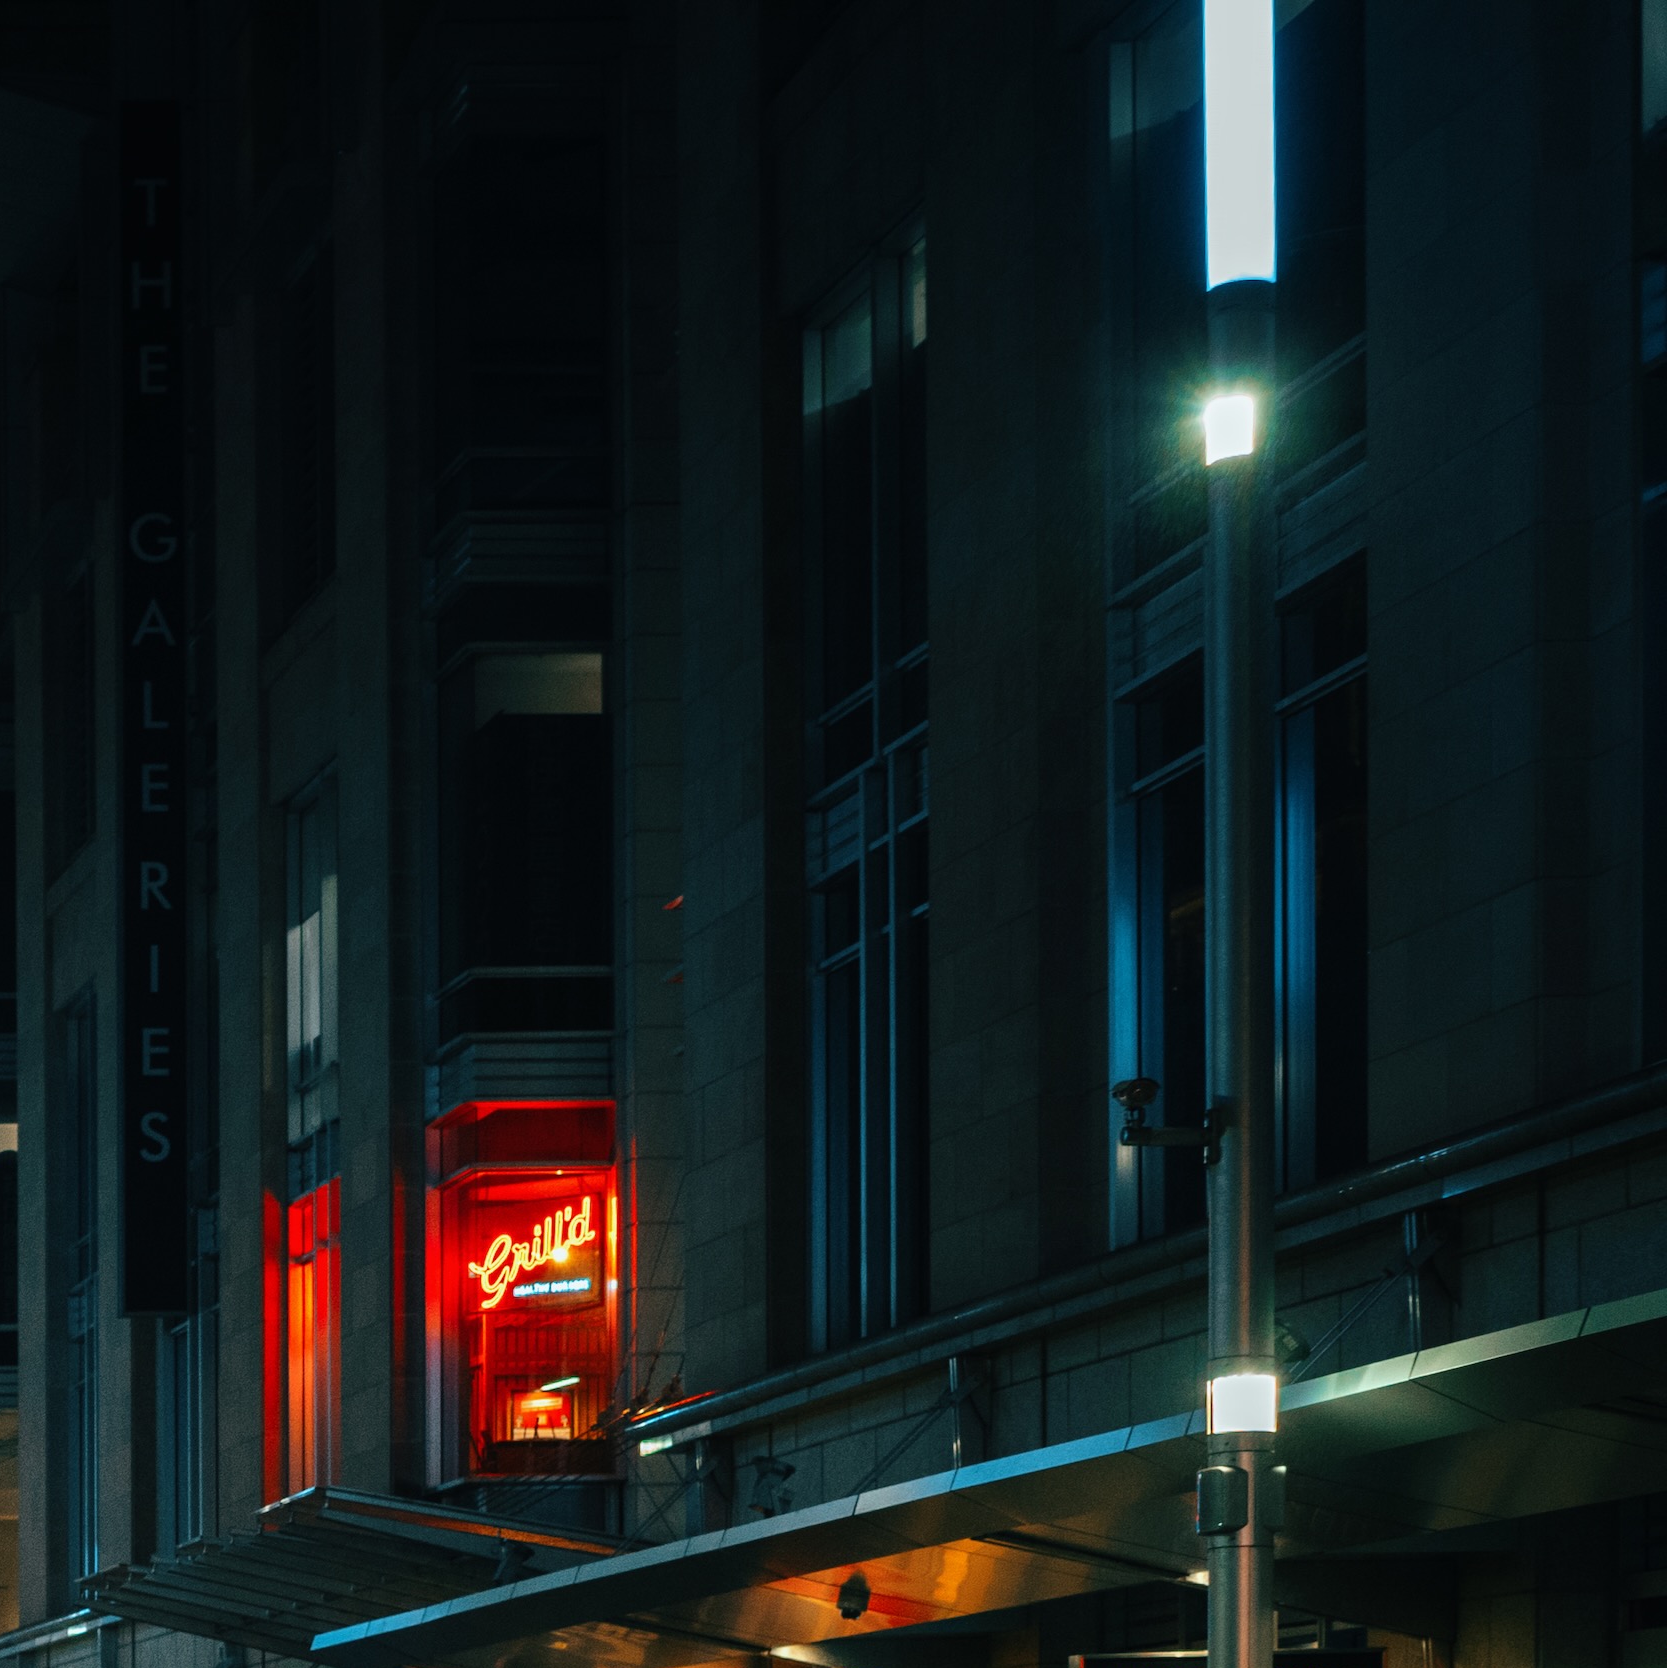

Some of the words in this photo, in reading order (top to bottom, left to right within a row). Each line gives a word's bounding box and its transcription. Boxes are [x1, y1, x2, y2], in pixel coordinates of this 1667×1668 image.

[130, 176, 173, 395] THE
[129, 512, 178, 1164] GALERIES
[468, 1196, 596, 1309] Grill'd
